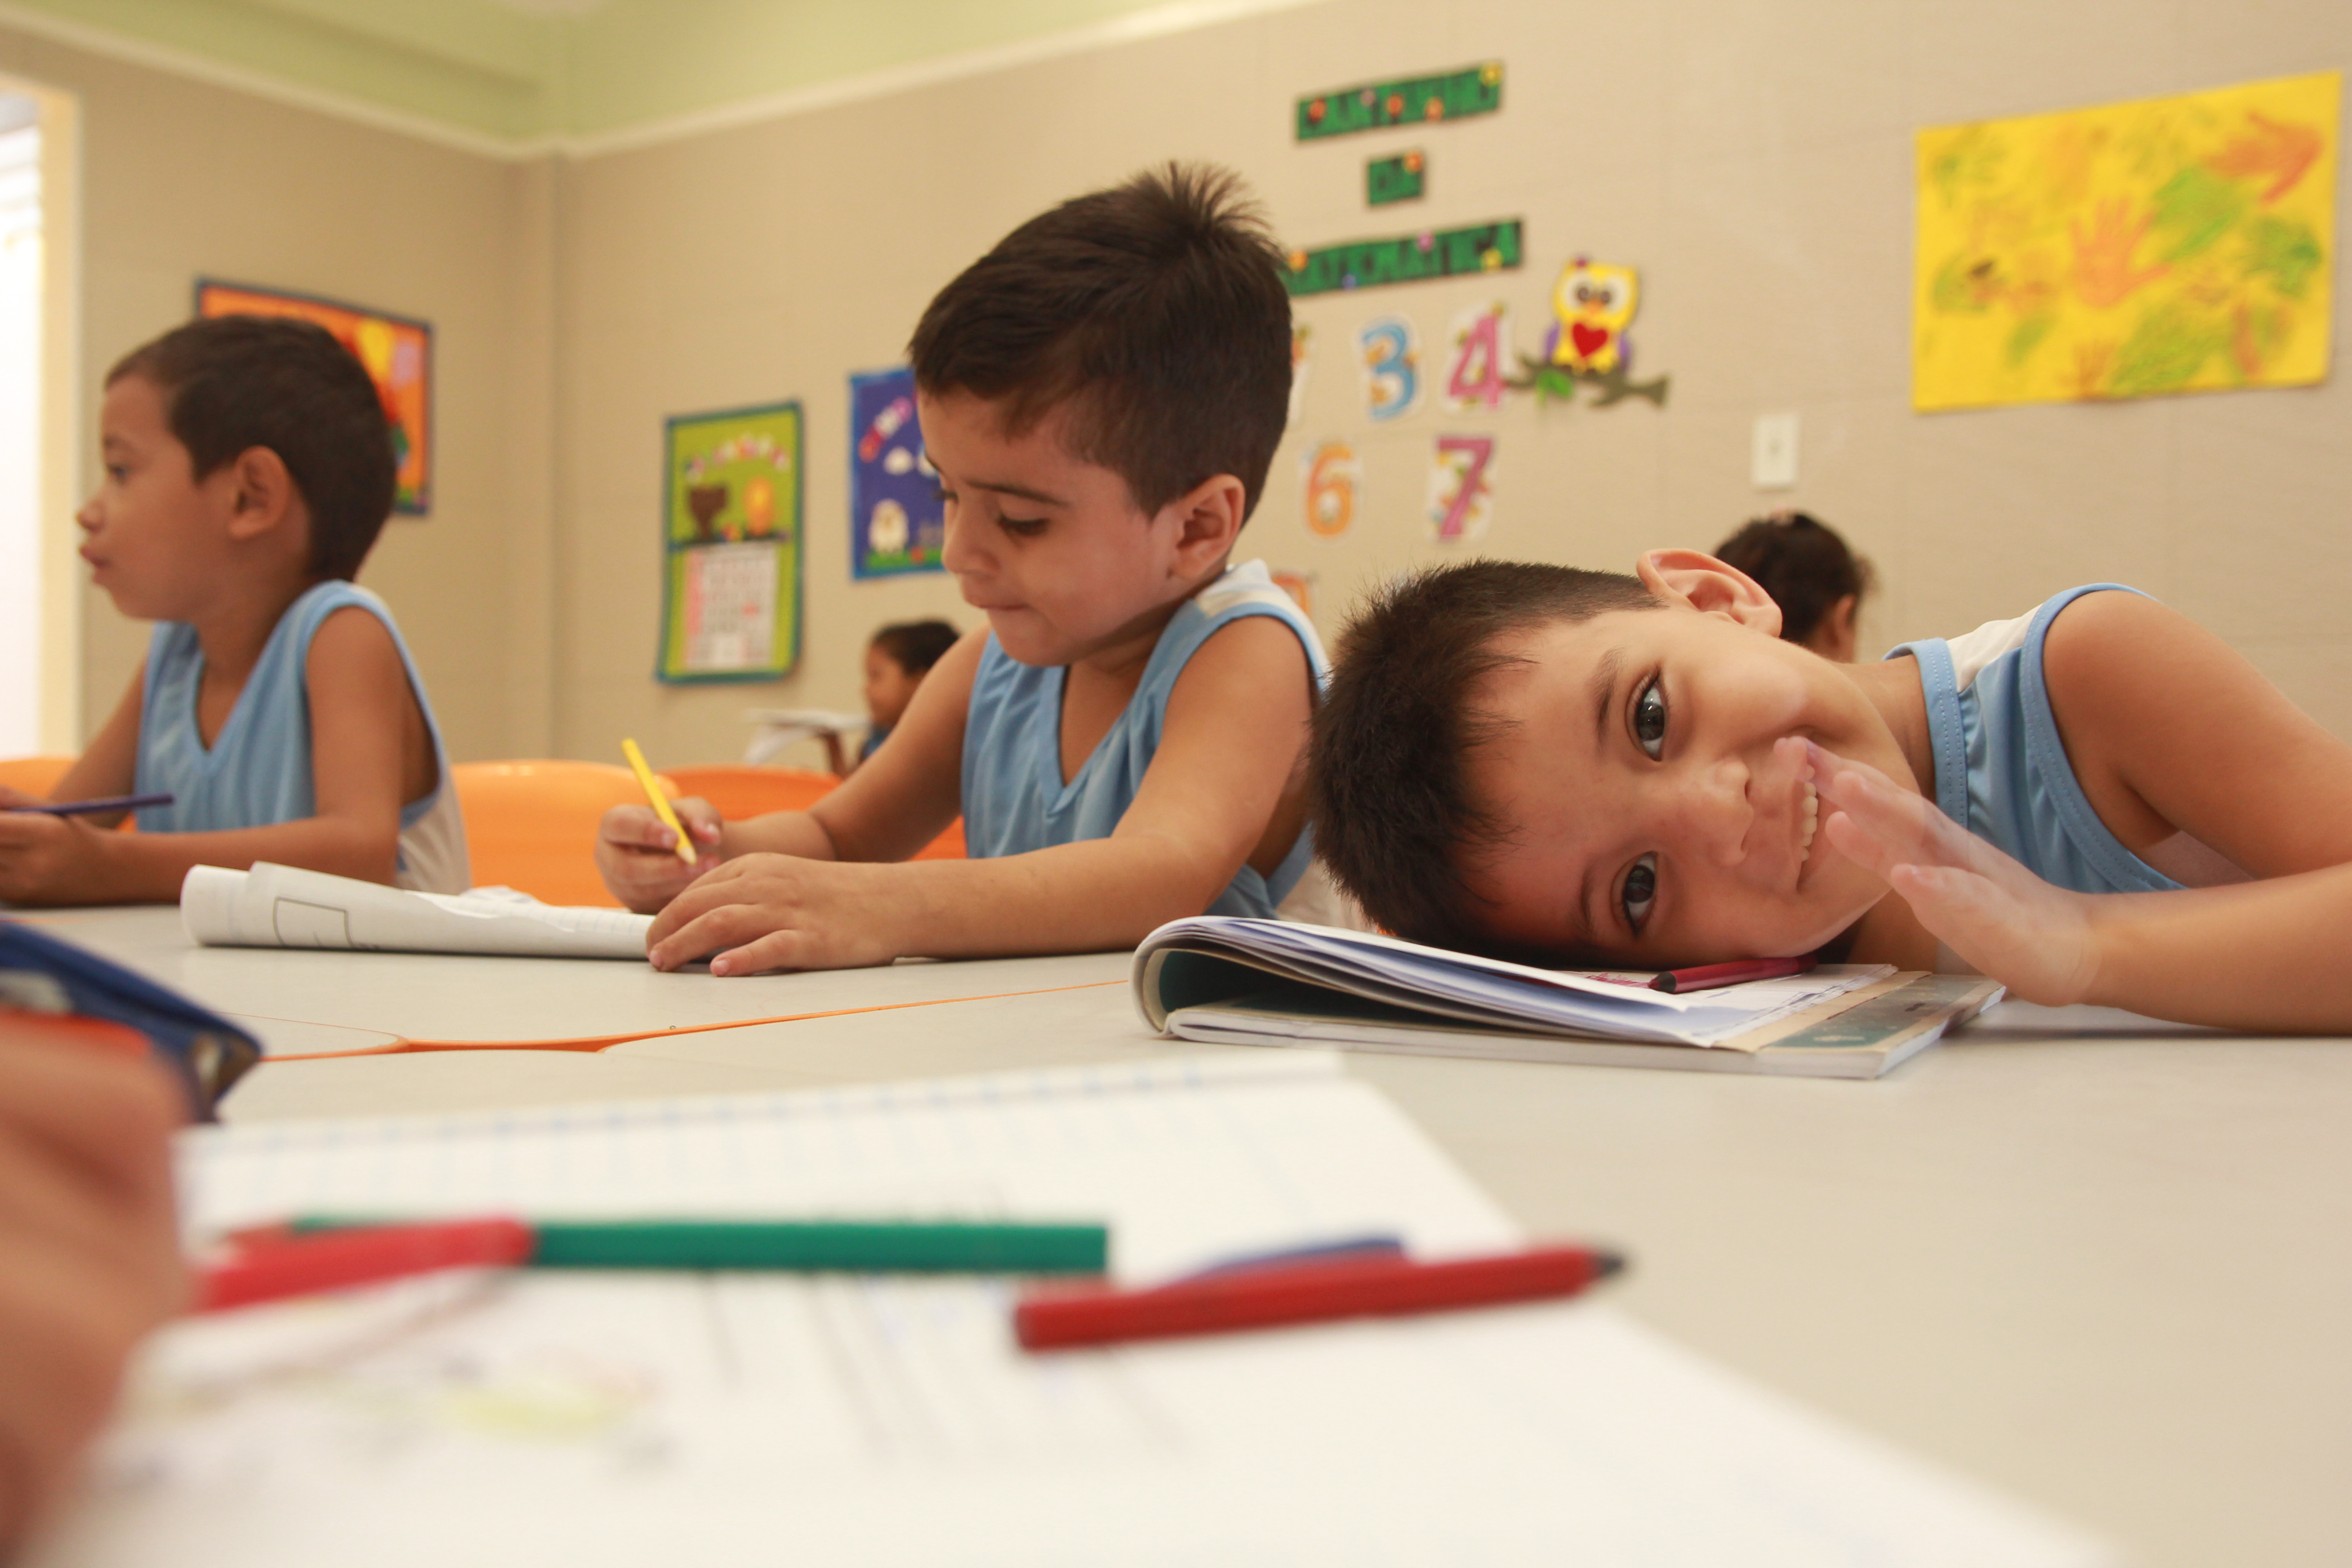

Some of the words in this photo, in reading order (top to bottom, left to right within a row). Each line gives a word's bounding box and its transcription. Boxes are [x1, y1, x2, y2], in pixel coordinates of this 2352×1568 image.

[1362, 322, 1416, 418] 3
[1447, 314, 1507, 409] 4
[1306, 442, 1354, 536] 6
[1437, 436, 1494, 540] 7
